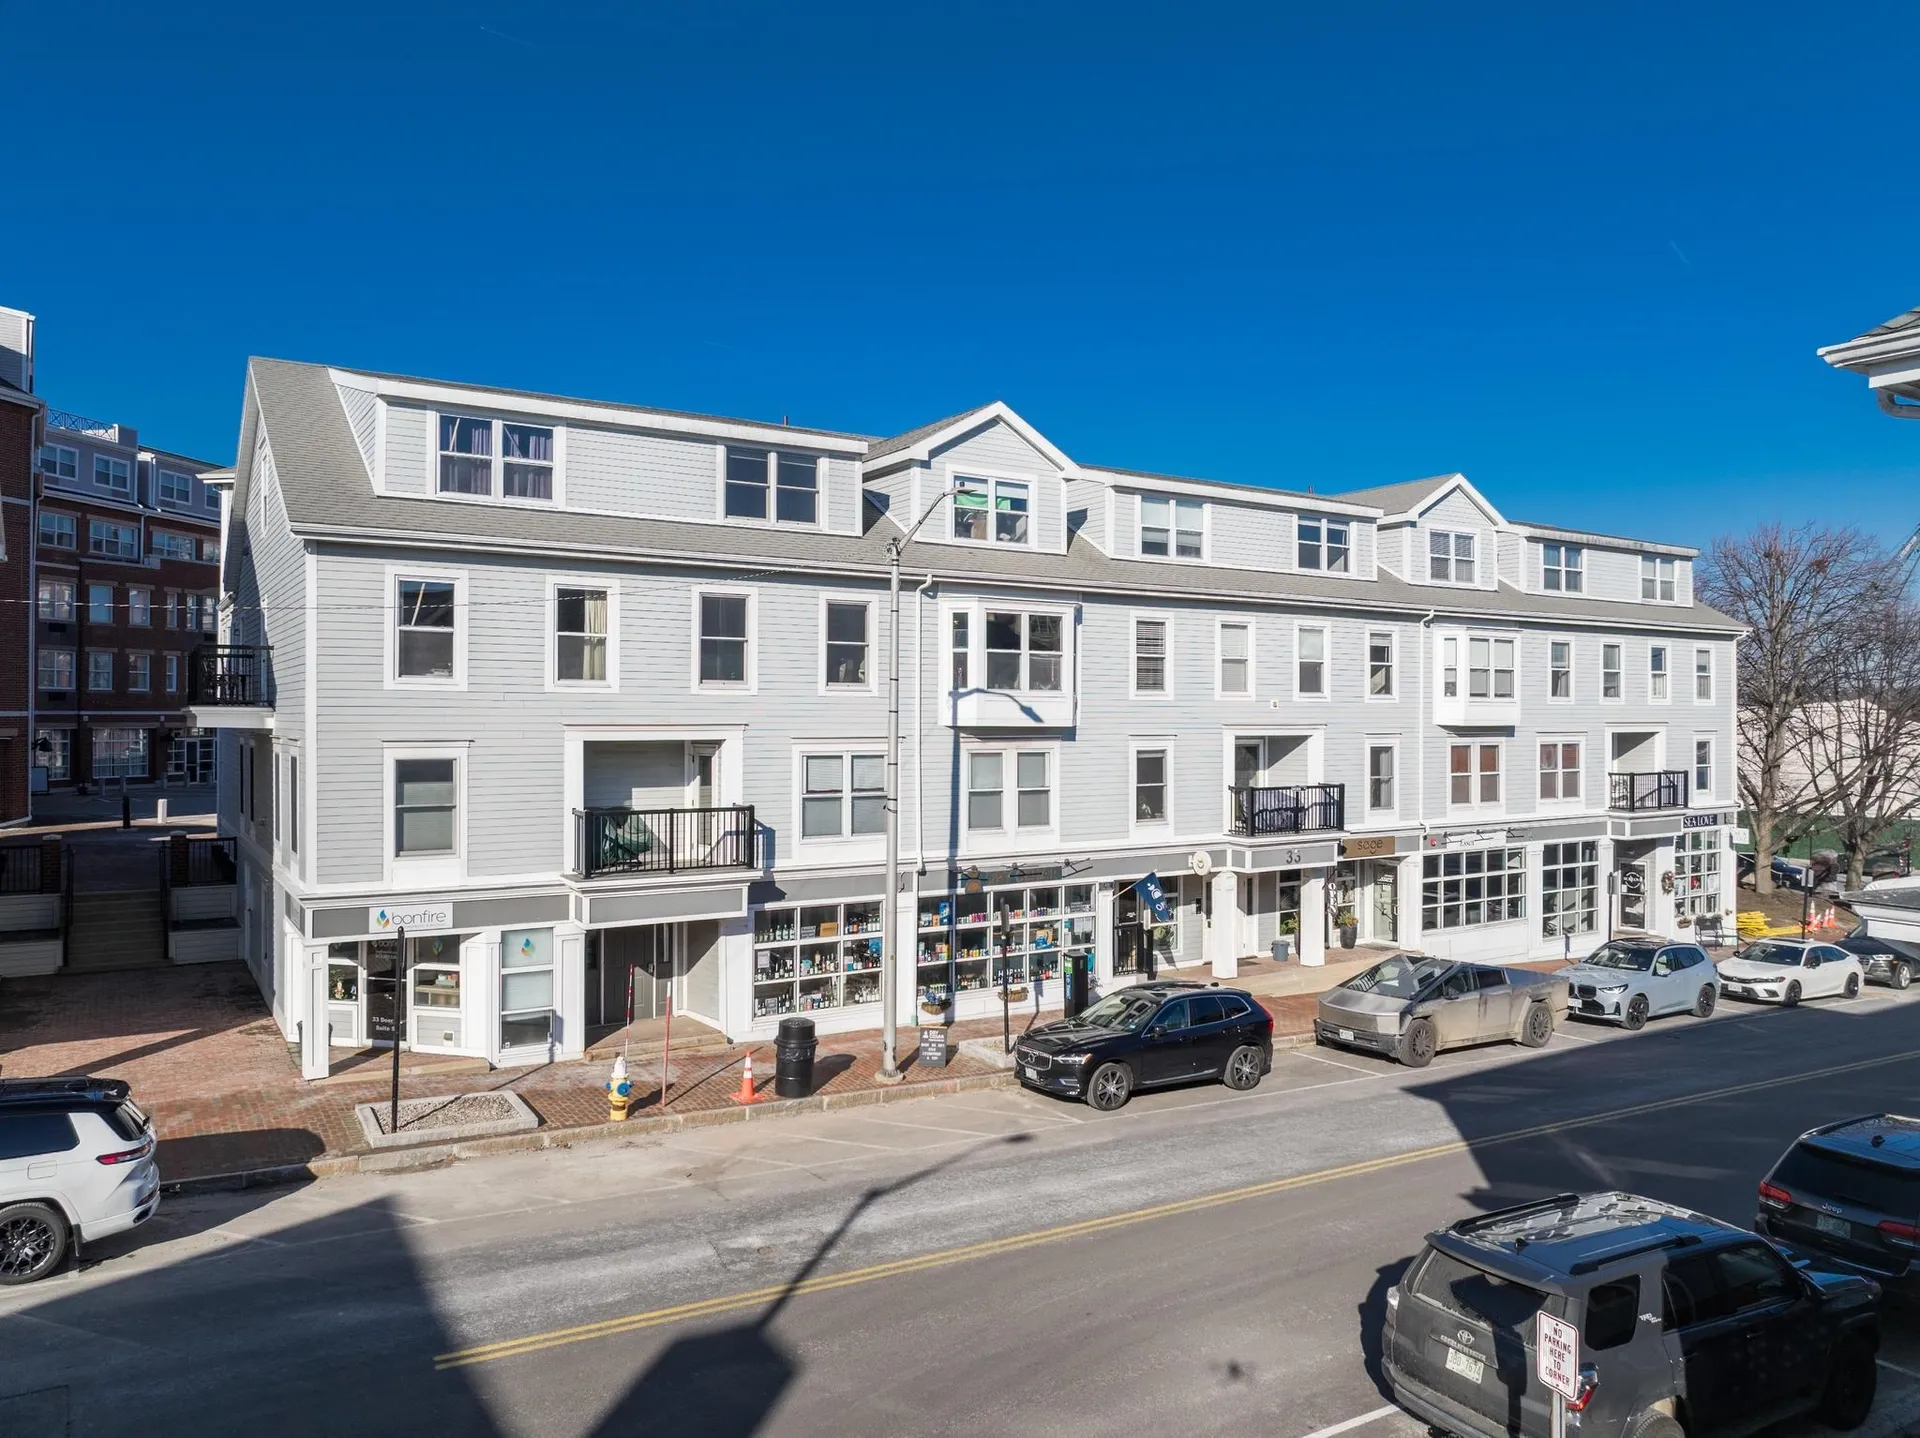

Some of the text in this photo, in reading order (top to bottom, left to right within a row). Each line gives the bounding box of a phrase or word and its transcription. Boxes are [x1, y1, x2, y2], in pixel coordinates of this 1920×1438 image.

[1684, 815, 1714, 827] SEA LOVE
[1286, 850, 1301, 864] 33
[392, 909, 447, 925] bonfire
[1822, 1202, 1843, 1214] Jeep
[1553, 1326, 1562, 1338] NO
[1544, 1333, 1571, 1354] PARKING
[1549, 1348, 1566, 1362] HERE
[1553, 1359, 1561, 1370] TO
[1545, 1366, 1570, 1386] CORNER
